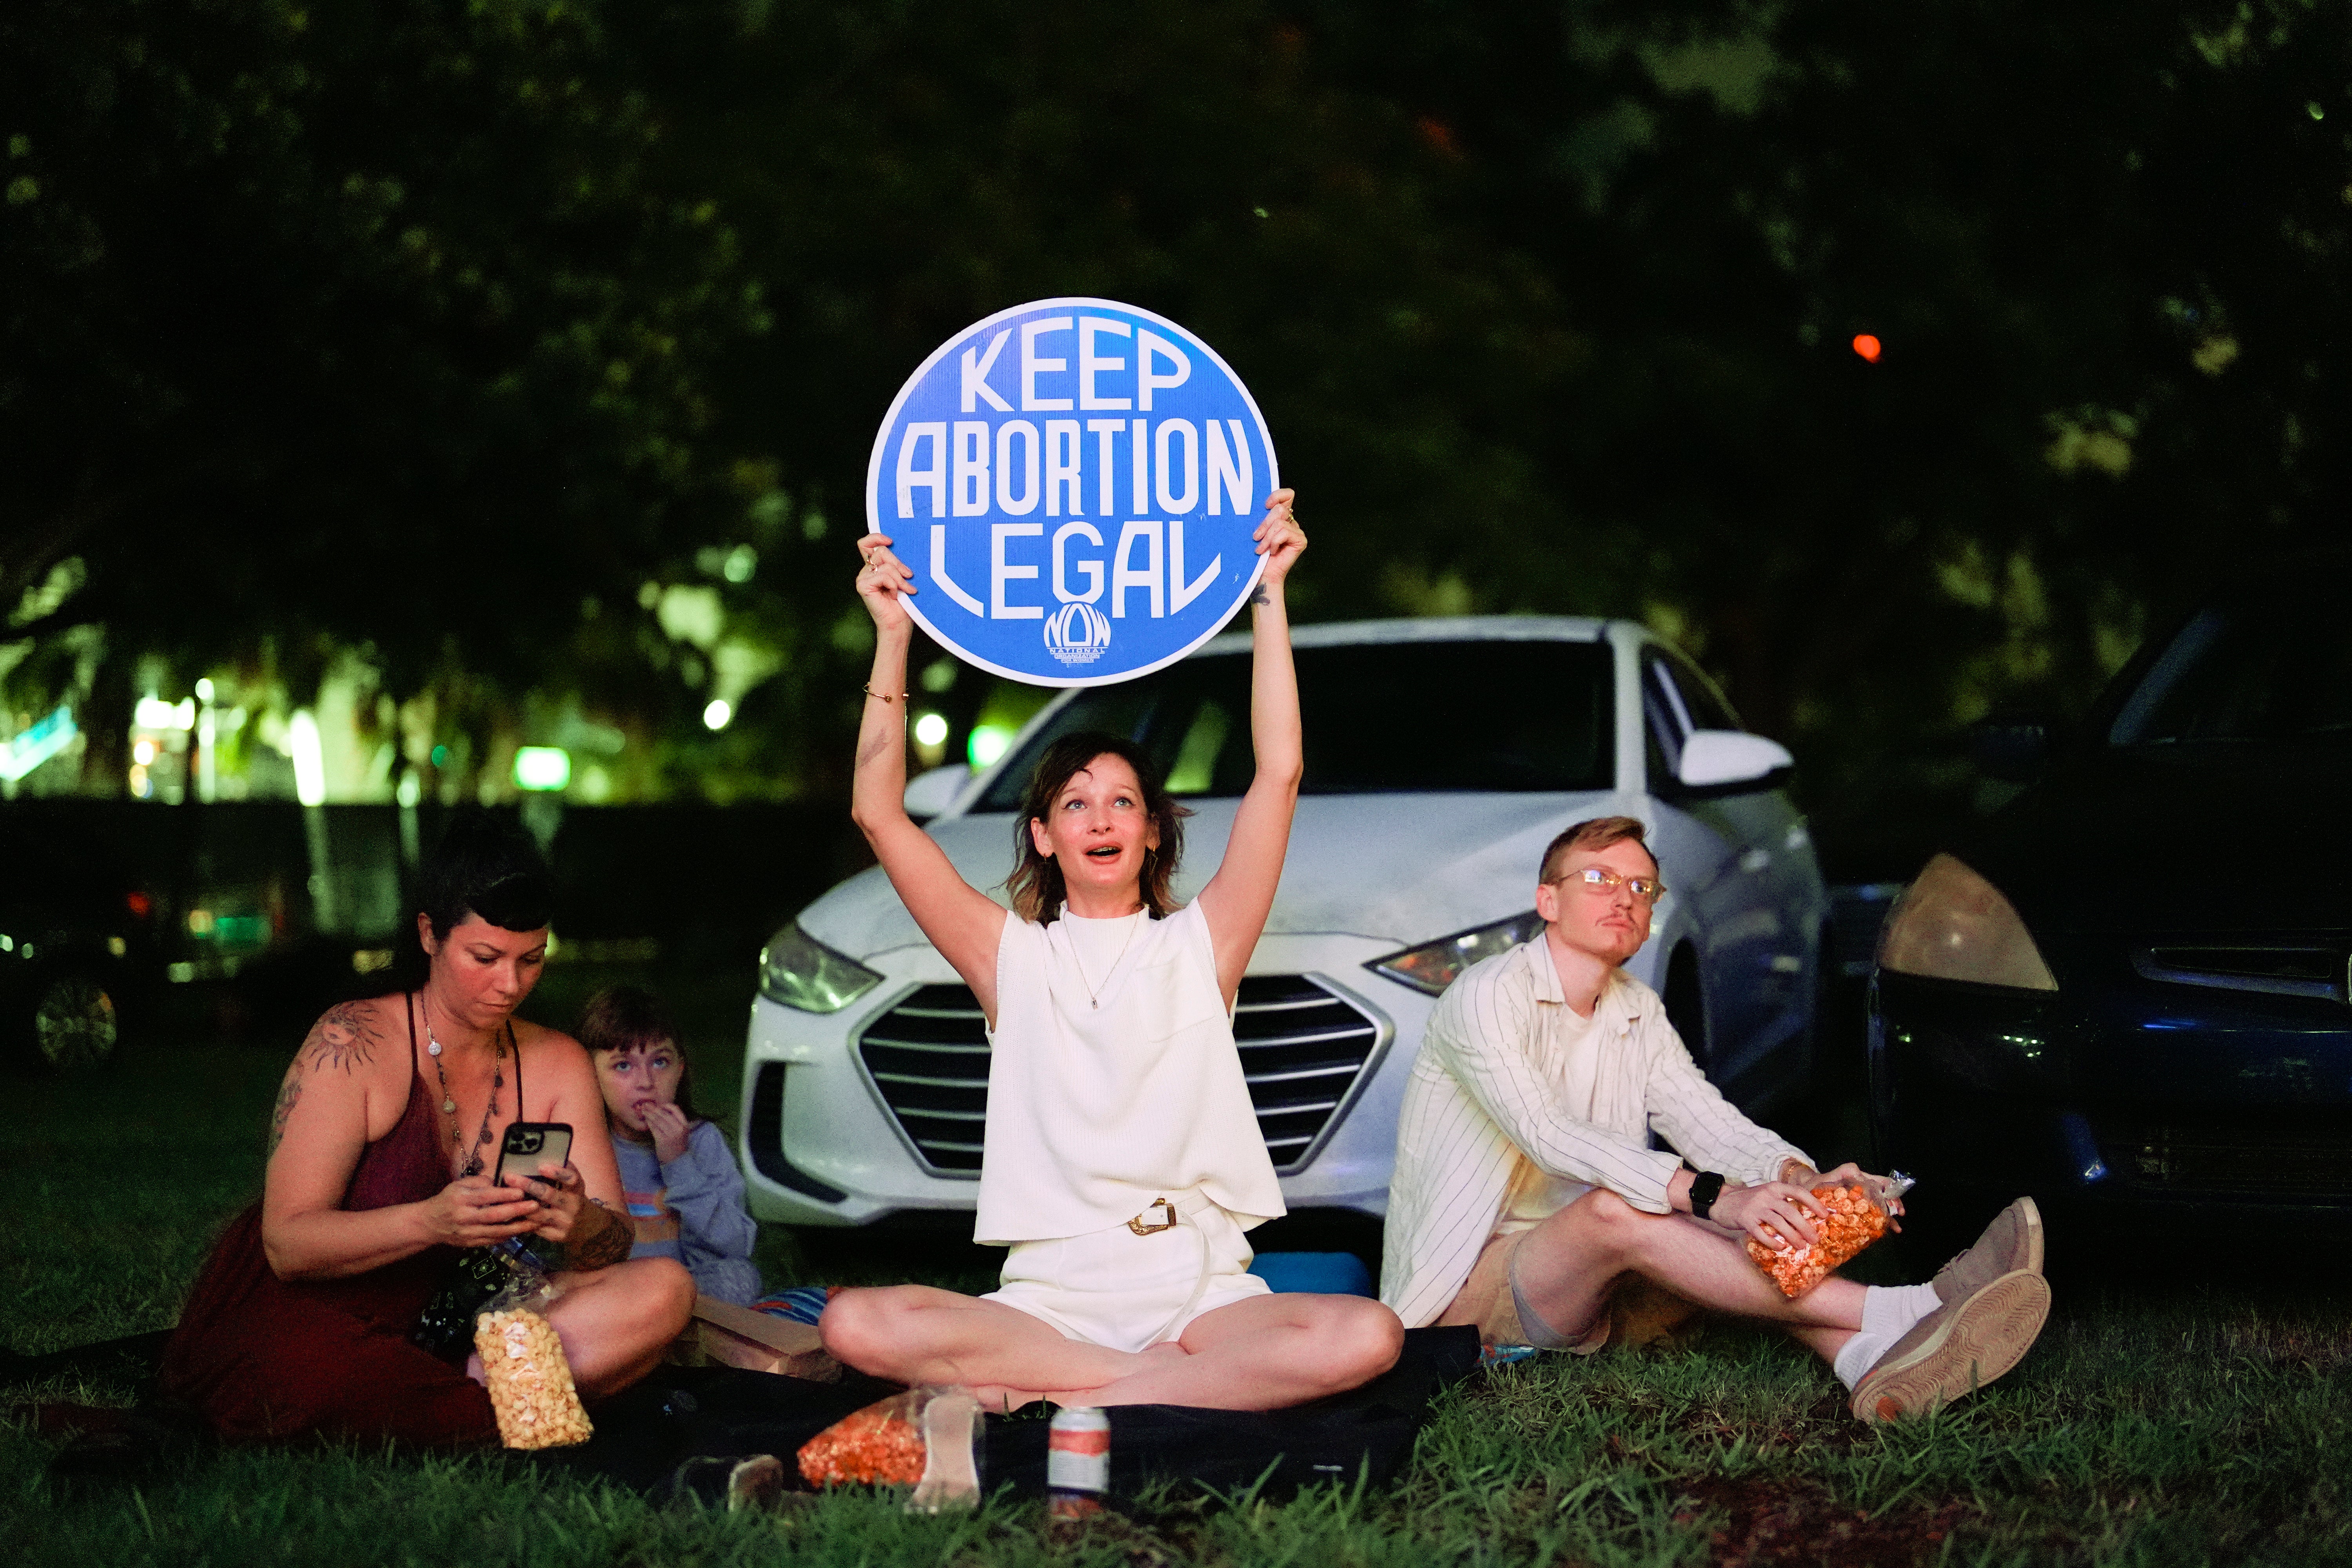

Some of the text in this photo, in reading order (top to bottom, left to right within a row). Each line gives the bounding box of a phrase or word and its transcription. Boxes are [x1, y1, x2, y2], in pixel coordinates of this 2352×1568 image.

[961, 316, 1191, 412] KEEP
[896, 419, 1253, 518] ABORTION
[930, 521, 1221, 619] LEGAL
[1044, 603, 1111, 647] NOW
